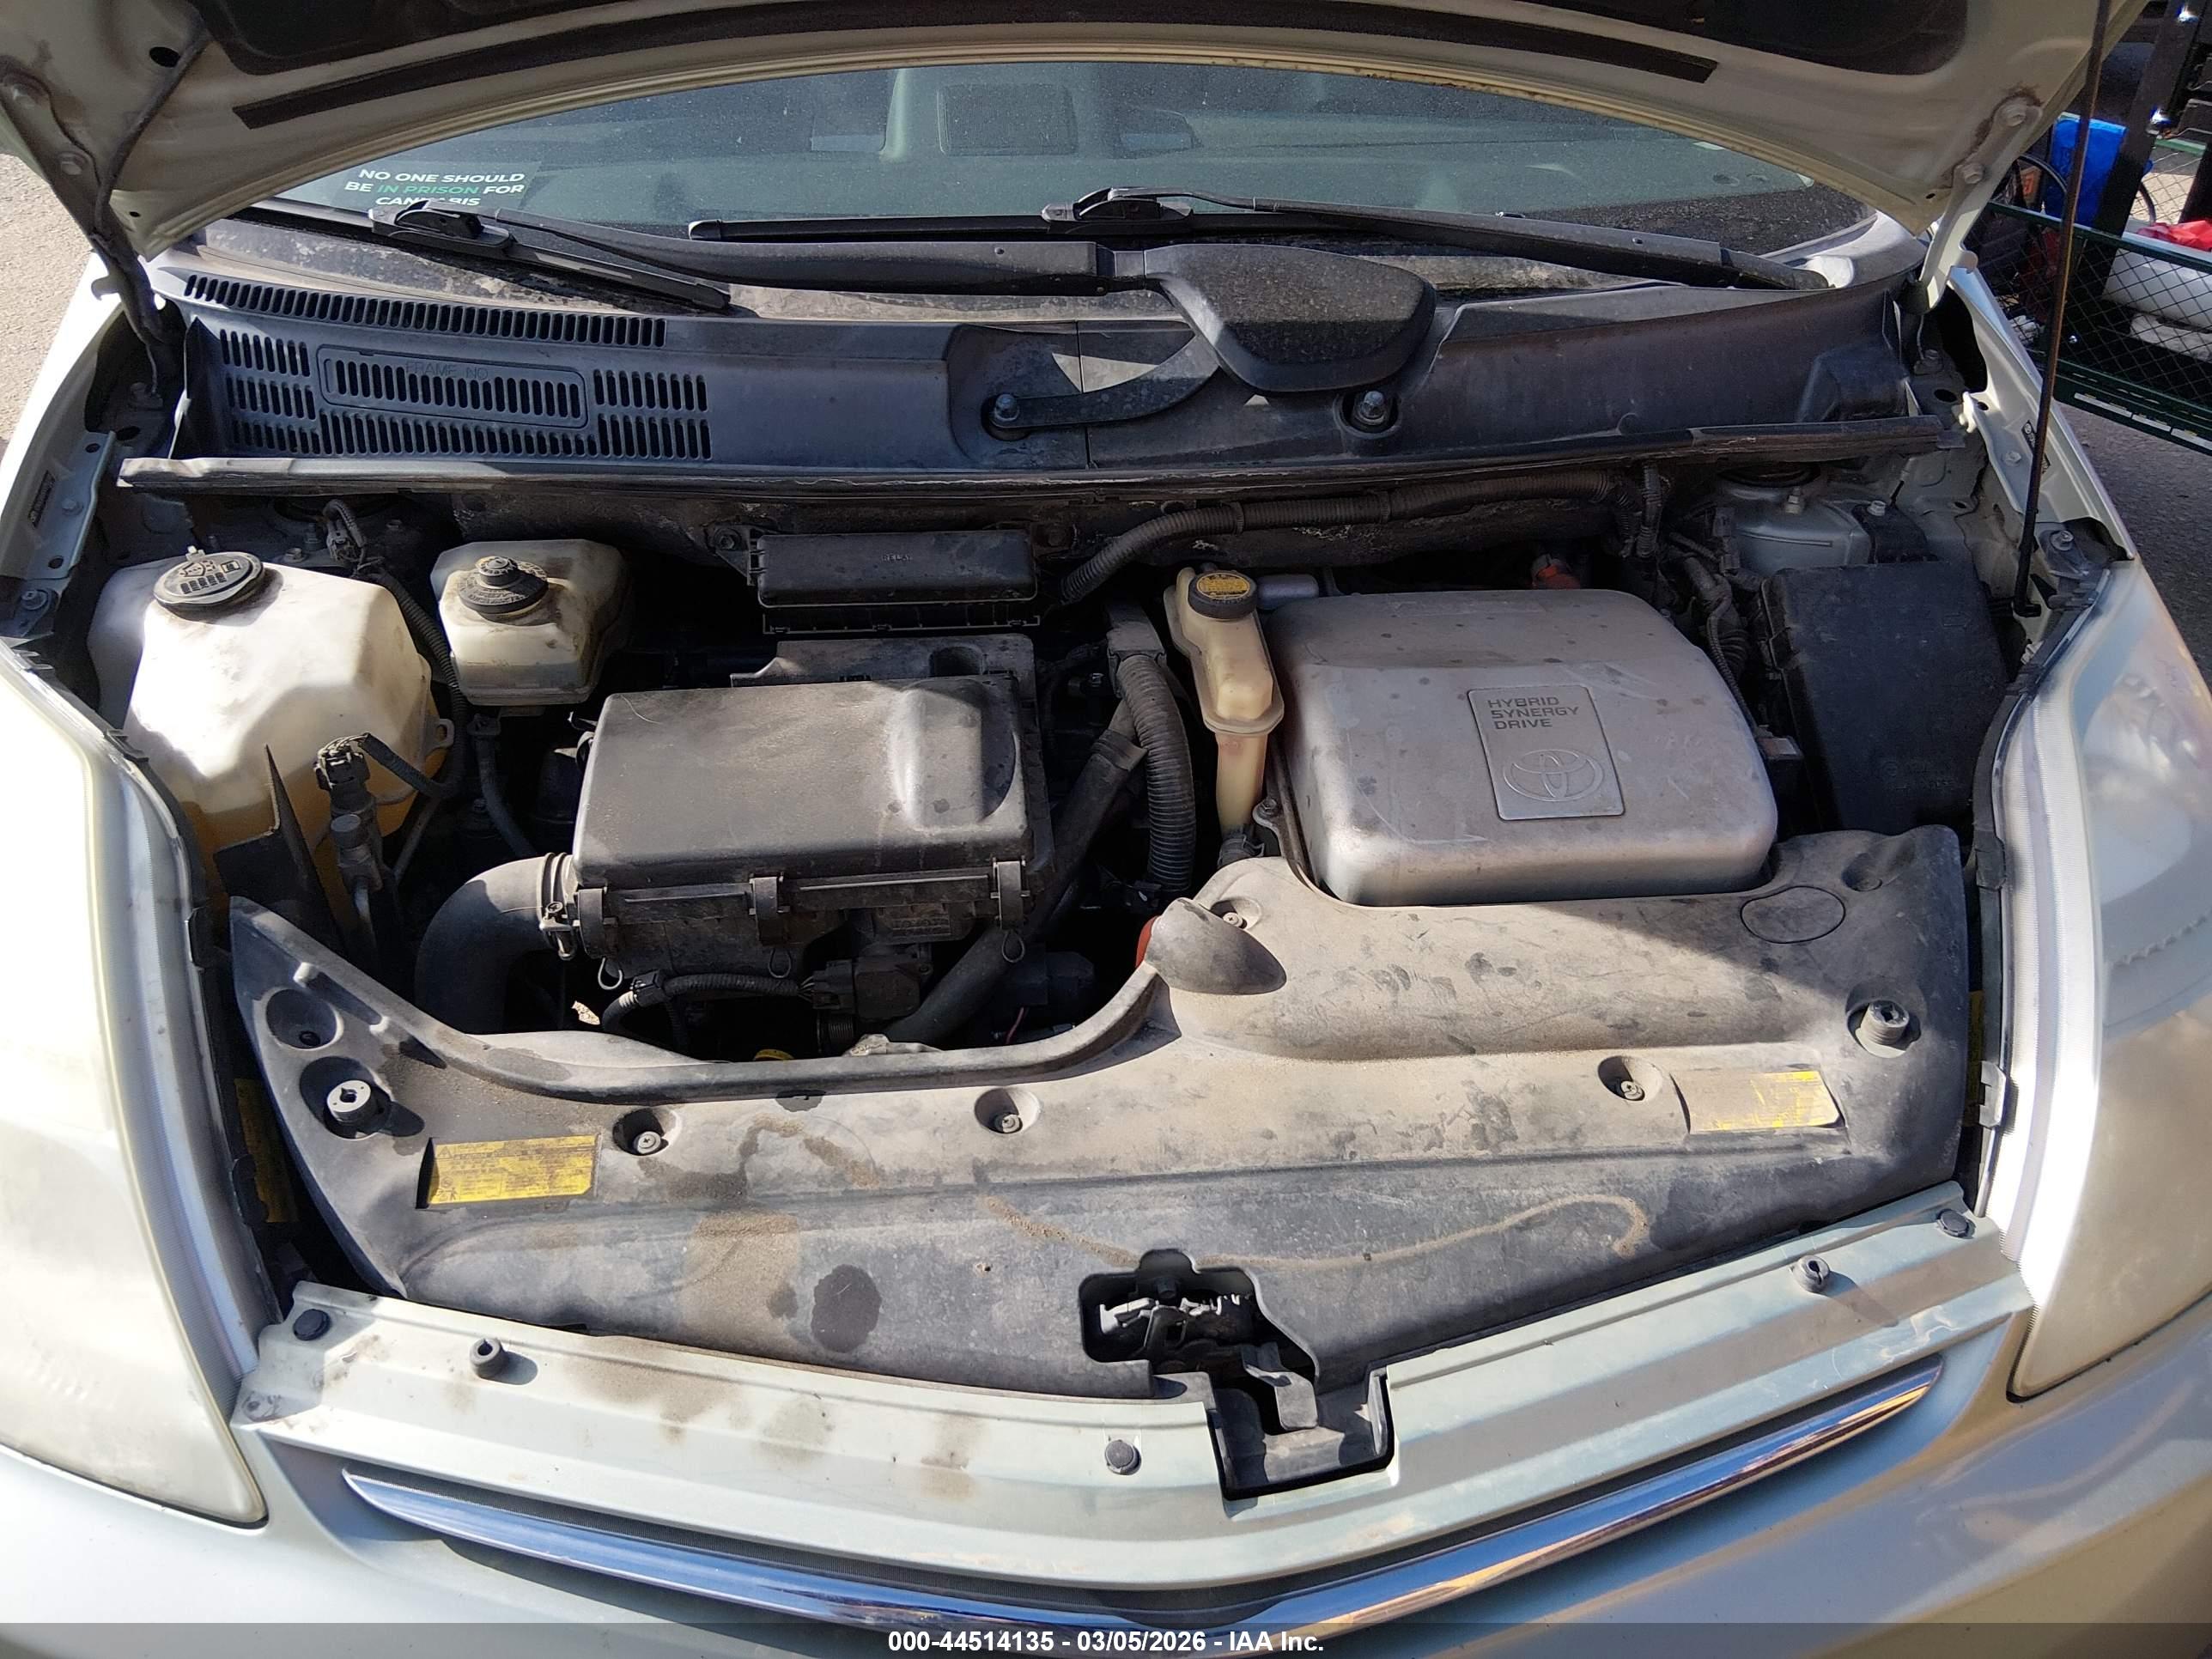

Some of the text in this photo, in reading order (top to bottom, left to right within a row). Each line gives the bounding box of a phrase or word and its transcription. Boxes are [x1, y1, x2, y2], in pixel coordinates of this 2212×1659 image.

[358, 169, 526, 183] NO ONE SHOULD
[344, 181, 526, 194] BE IN PRISON FOR
[405, 362, 457, 378] FRAME
[1487, 696, 1560, 708] HYBRID
[1490, 706, 1579, 720] SYNERGY
[1493, 719, 1553, 730] DRIVE
